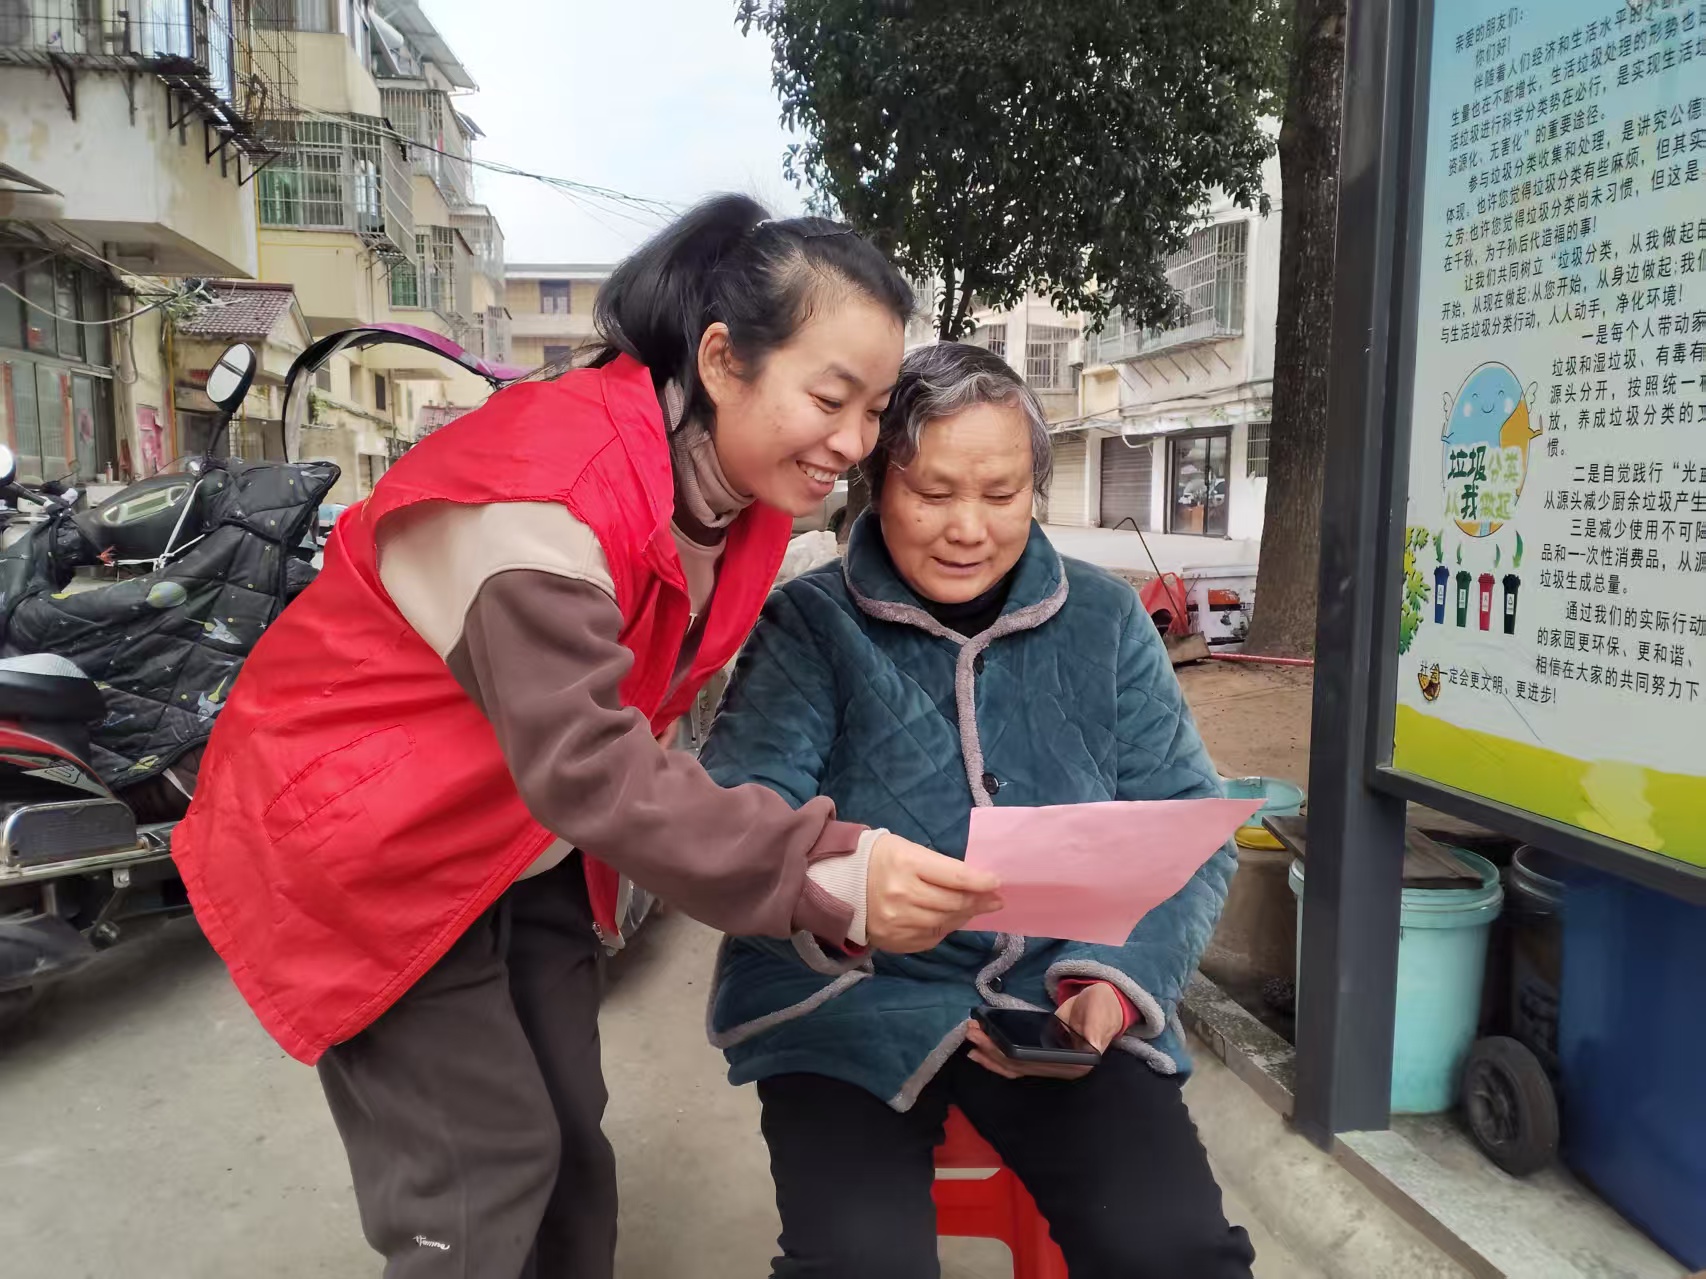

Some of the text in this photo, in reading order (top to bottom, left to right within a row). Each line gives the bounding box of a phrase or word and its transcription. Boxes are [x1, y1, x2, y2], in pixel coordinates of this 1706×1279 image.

[1540, 568, 1628, 594] 垃圾生成总量。
[1535, 655, 1700, 702] 相信在大家的共同努力下
